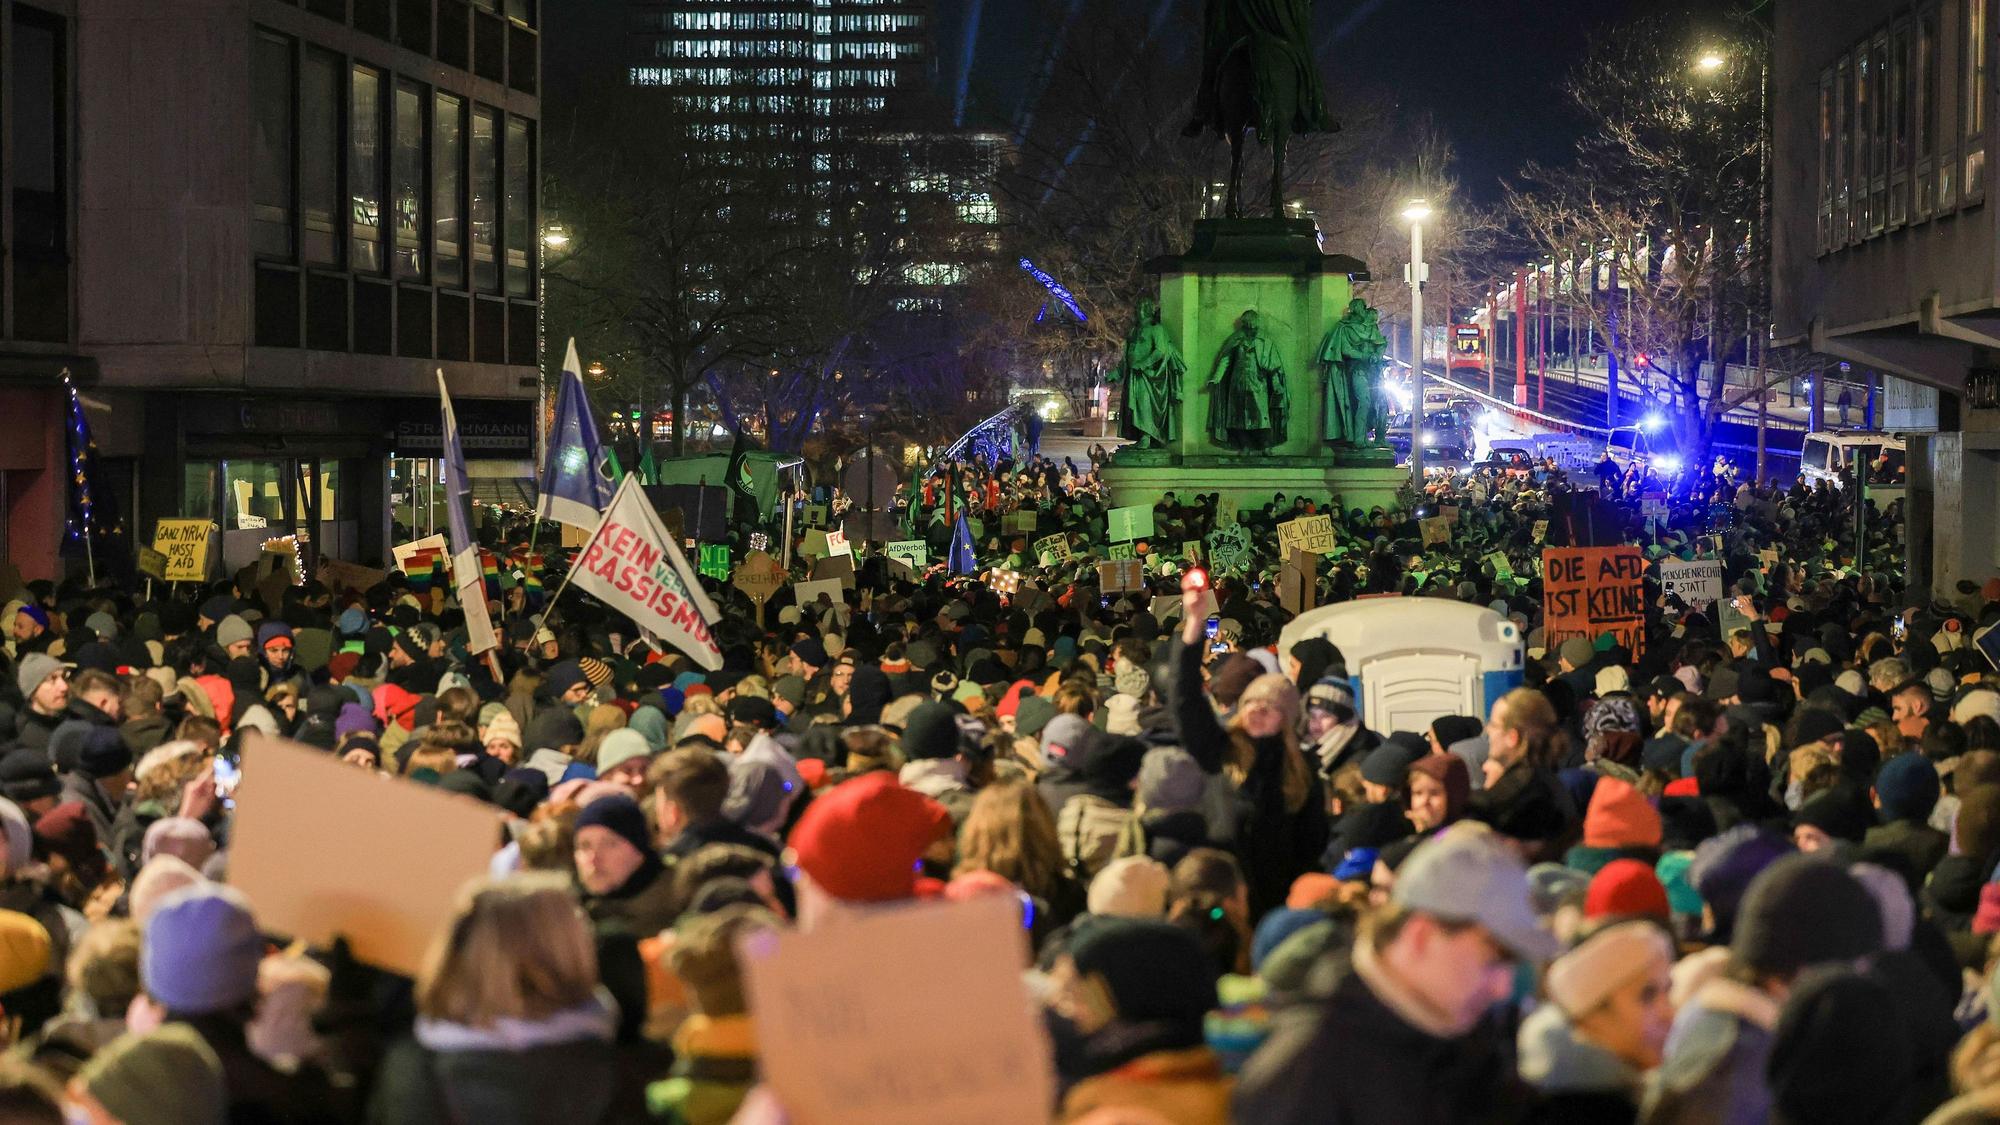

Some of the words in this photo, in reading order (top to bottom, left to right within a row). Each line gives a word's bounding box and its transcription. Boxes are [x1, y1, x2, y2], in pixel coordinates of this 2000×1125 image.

[400, 421, 529, 435] STRAHMANN
[157, 526, 180, 540] GANZ
[180, 525, 208, 542] NRW
[1278, 522, 1298, 541] NIE
[1298, 517, 1331, 536] WIEDER
[829, 532, 846, 546] FC
[1306, 533, 1333, 550] JETZT
[168, 544, 195, 557] HASST
[602, 523, 661, 573] KEIN
[1549, 557, 1586, 582] DIE
[1598, 555, 1642, 581] AFD
[1680, 580, 1707, 593] STATT
[1546, 588, 1581, 618] IST
[1587, 584, 1644, 618] KEINE
